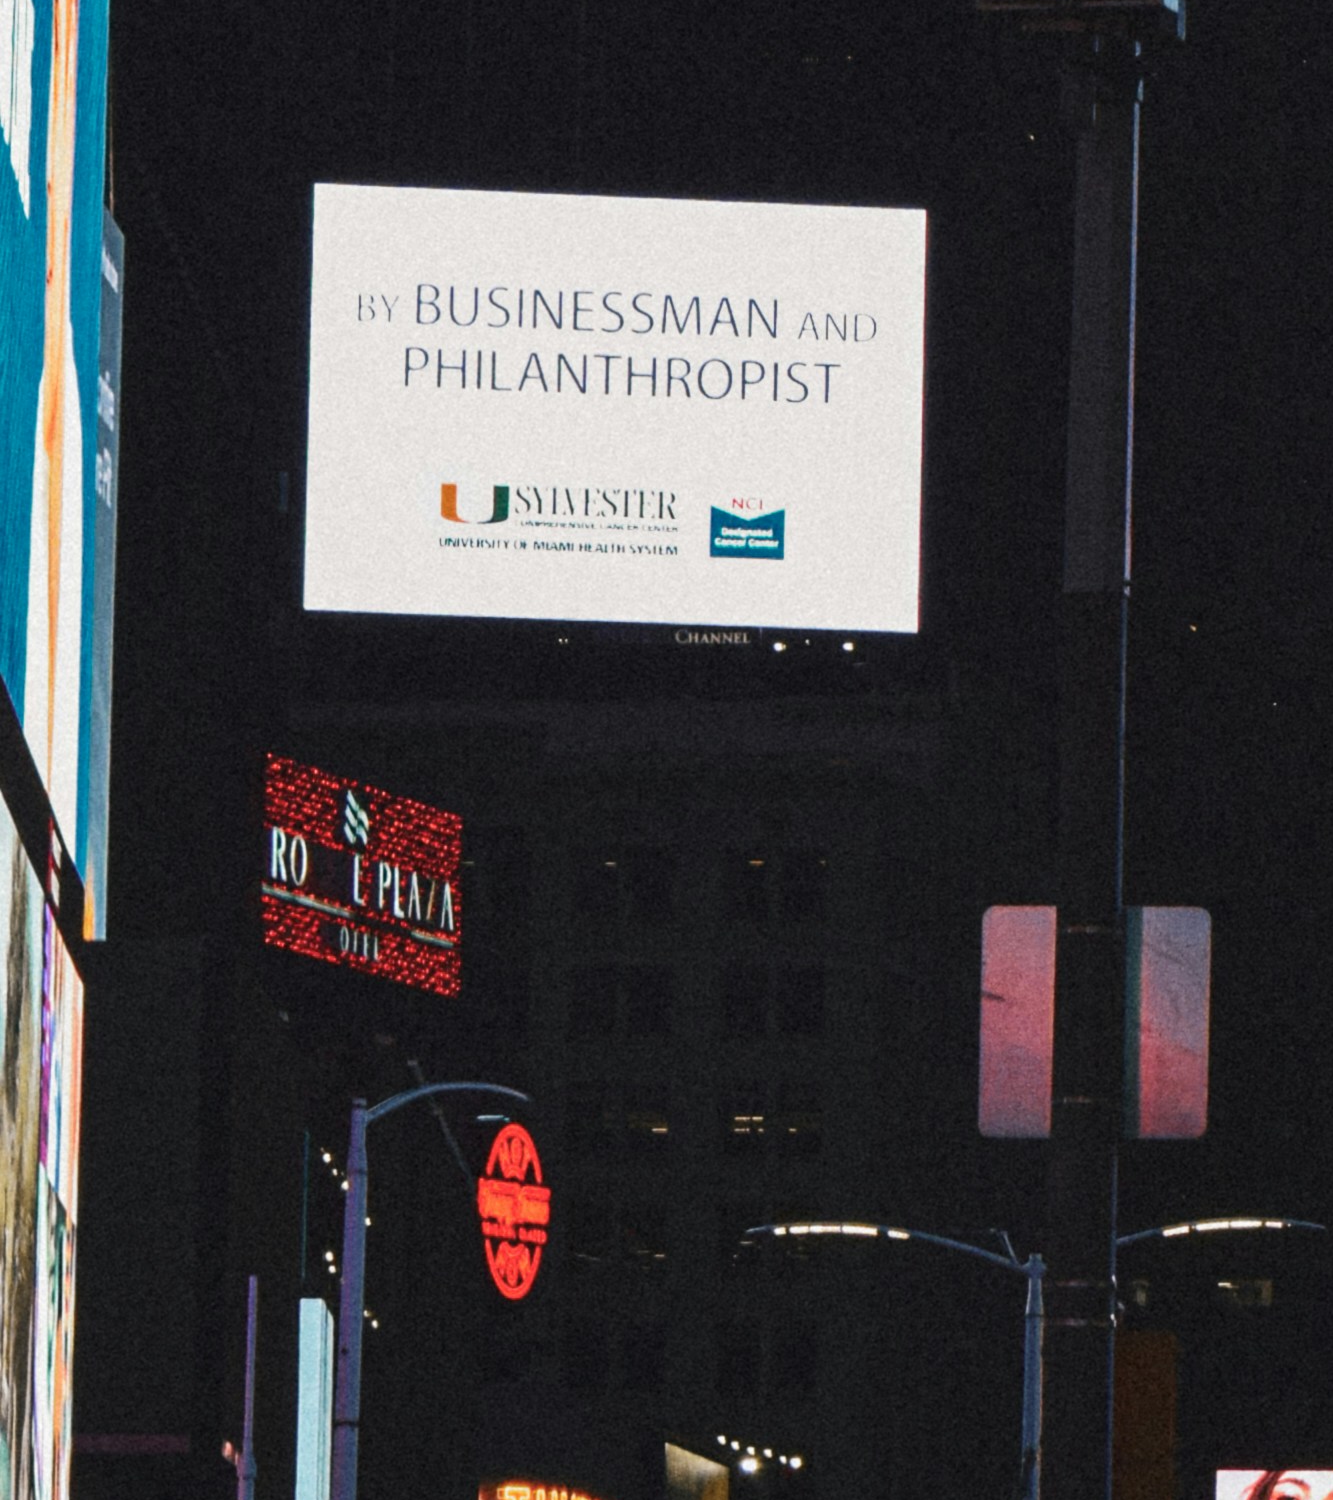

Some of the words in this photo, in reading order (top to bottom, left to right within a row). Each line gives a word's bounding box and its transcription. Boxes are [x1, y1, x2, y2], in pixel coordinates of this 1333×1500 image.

[358, 293, 400, 323] BY
[416, 283, 779, 339] BUSINESSMAN
[798, 312, 878, 343] AND
[403, 347, 842, 405] PHILANTHROPIST
